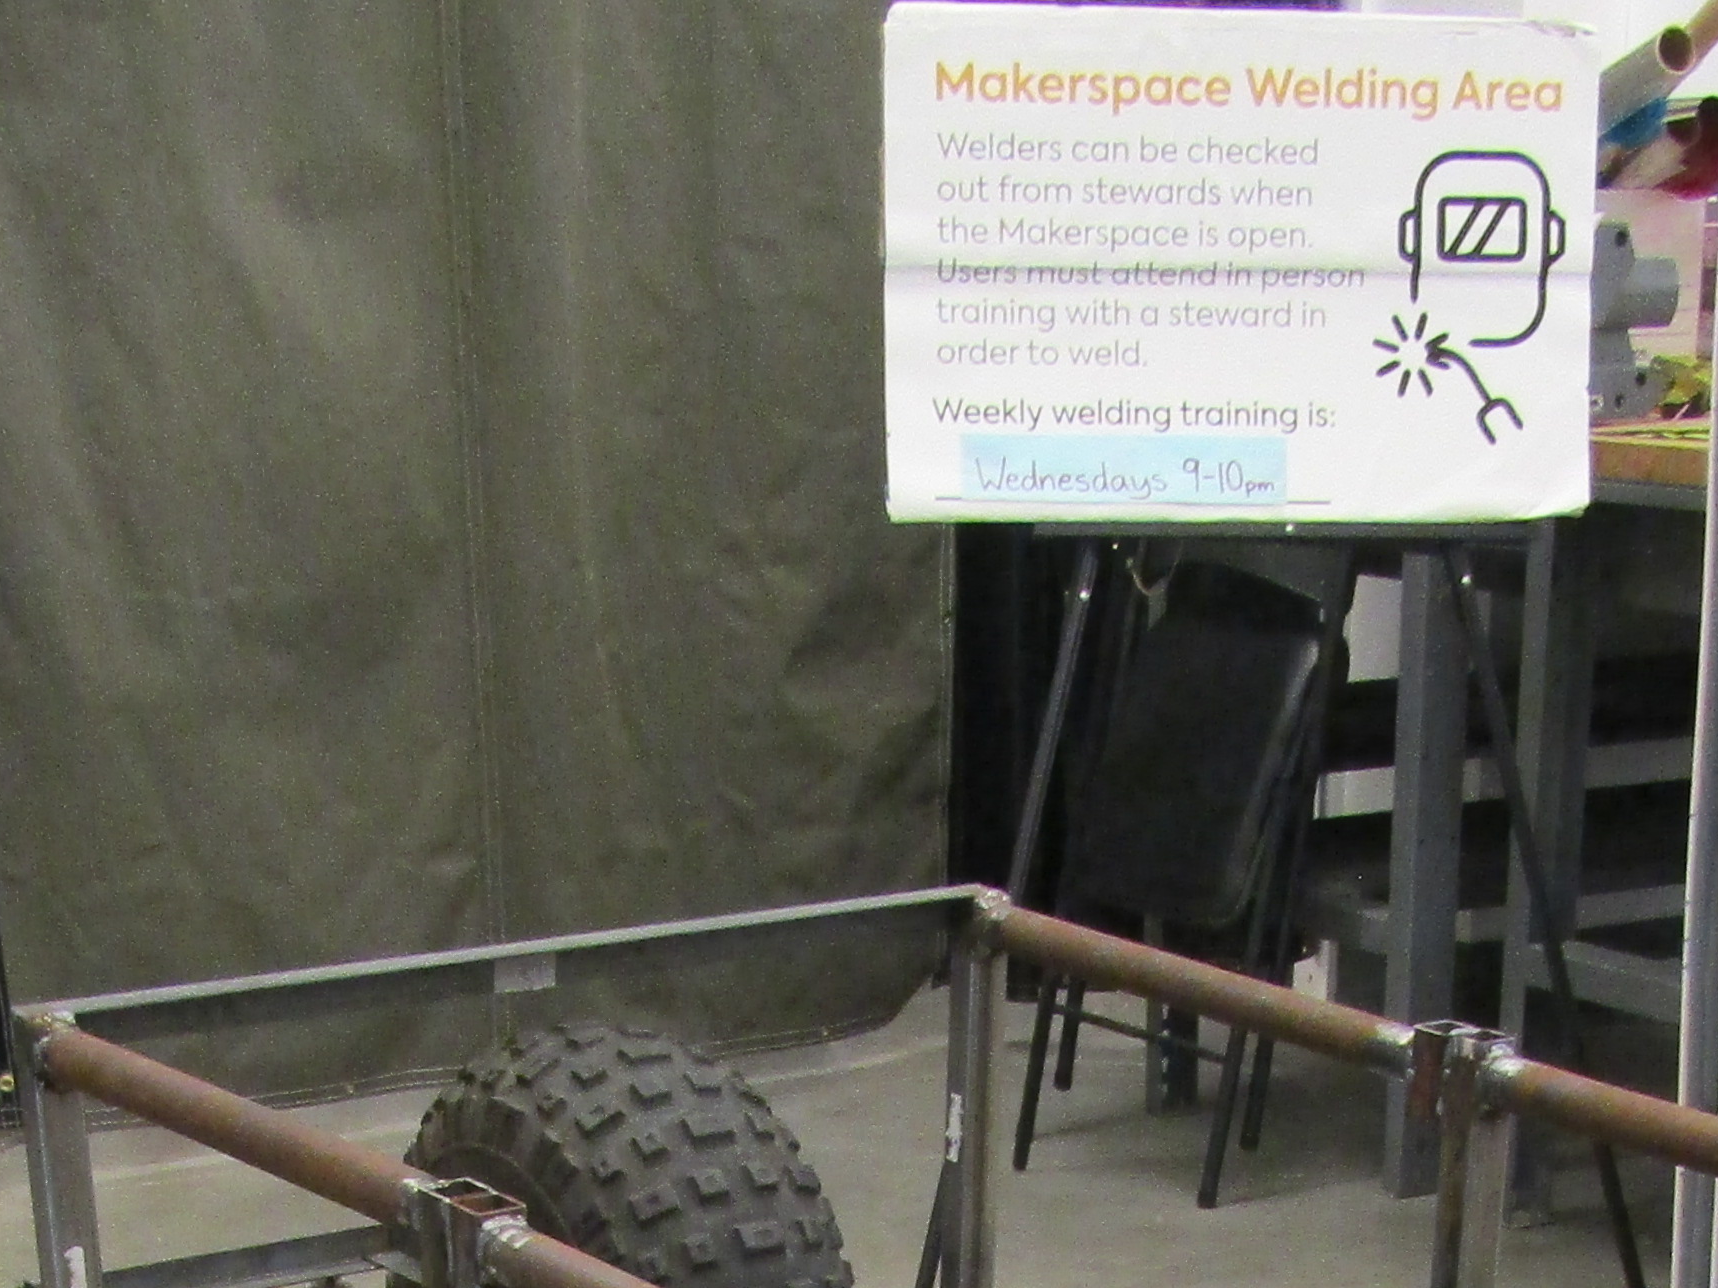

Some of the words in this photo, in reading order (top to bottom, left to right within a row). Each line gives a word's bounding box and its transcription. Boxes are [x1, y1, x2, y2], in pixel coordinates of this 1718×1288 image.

[936, 60, 1231, 114] Makerspace
[1246, 66, 1440, 120] Welding
[1454, 70, 1563, 111] Area
[937, 131, 1062, 162] Welders
[1071, 138, 1130, 162] can
[1140, 134, 1178, 163] be
[1187, 135, 1319, 165] checked
[937, 175, 989, 203] out
[999, 175, 1072, 203] from
[1083, 176, 1221, 206] stewards
[1231, 178, 1312, 206] when
[937, 215, 988, 244] the
[999, 216, 1189, 250] Makerspace
[1199, 220, 1218, 247] is
[1228, 223, 1312, 252] open.
[935, 258, 1021, 284] Users
[1025, 261, 1105, 284] must
[1111, 260, 1219, 286] attend
[1224, 261, 1255, 285] in
[1259, 262, 1367, 292] person
[937, 298, 1056, 333] training
[1065, 299, 1130, 326] with
[1140, 305, 1159, 326] a
[1170, 300, 1292, 328] steward
[1302, 301, 1326, 327] in
[937, 338, 1019, 365] order
[1027, 339, 1059, 366] to
[1068, 339, 1147, 367] weld.
[933, 398, 1043, 431] Weekly
[1052, 398, 1171, 433] welding
[1180, 400, 1298, 434] training
[1308, 401, 1335, 428] is:
[975, 455, 1169, 500] Wednesdays
